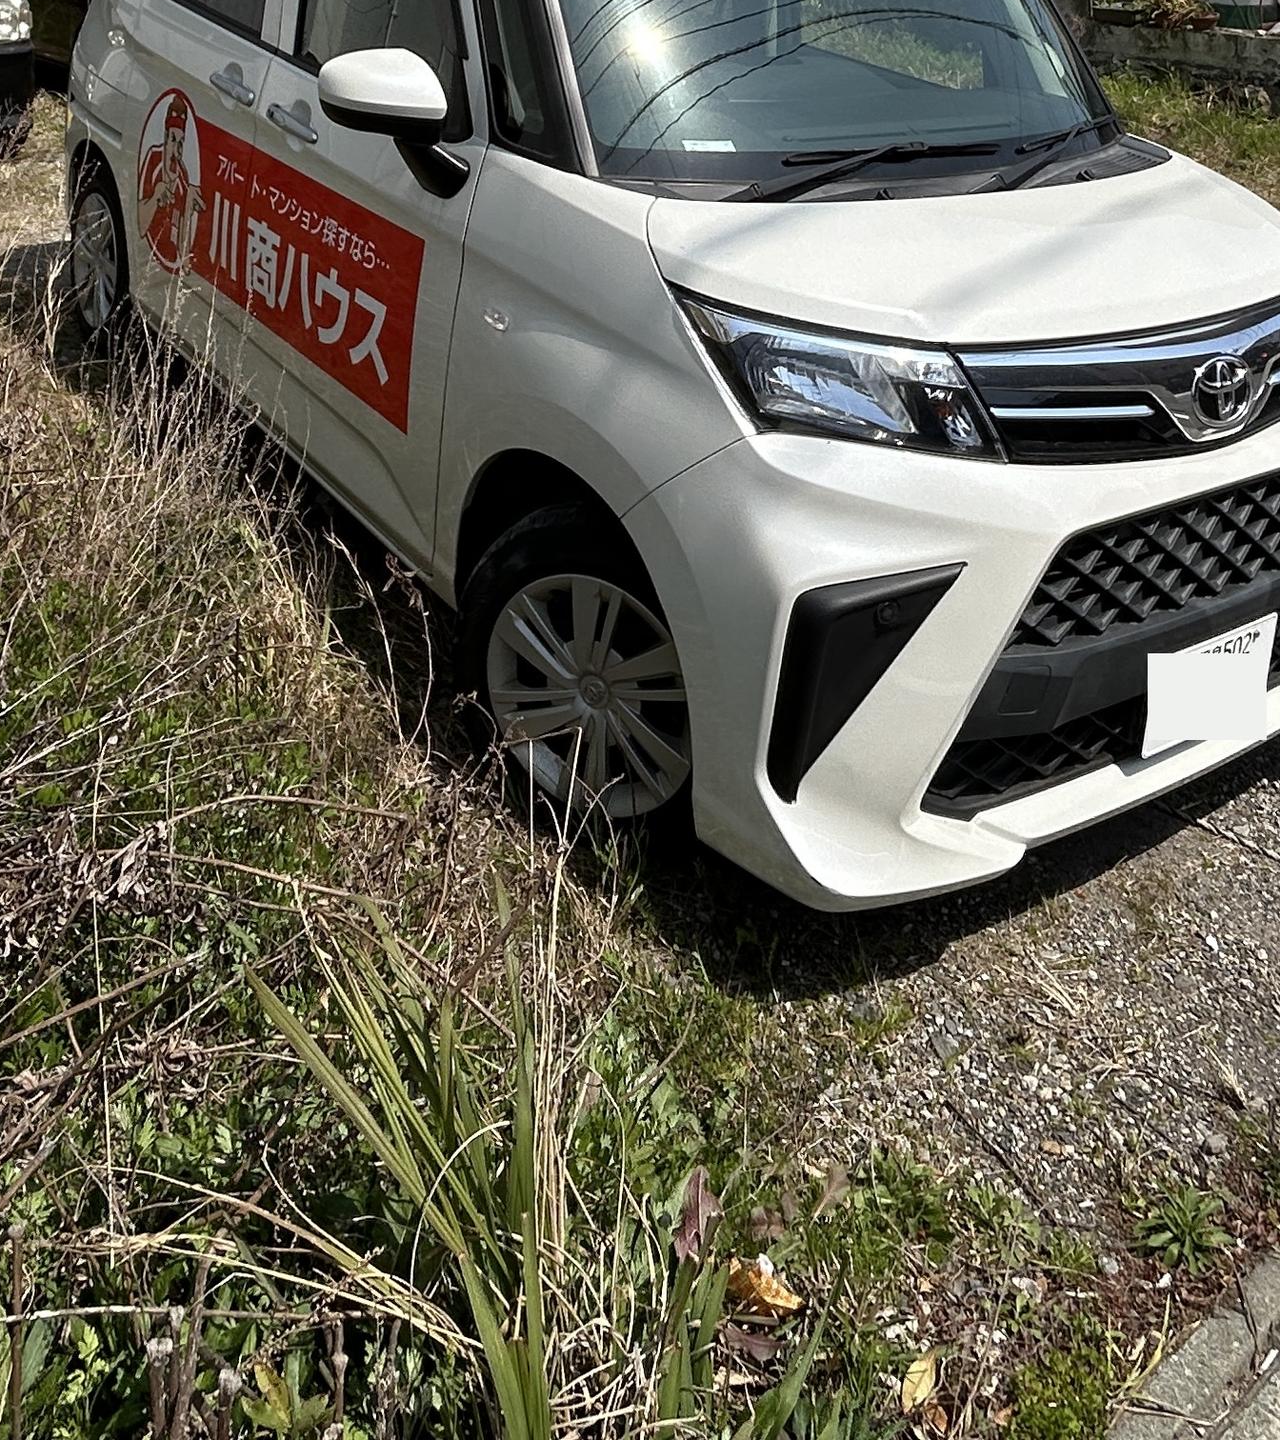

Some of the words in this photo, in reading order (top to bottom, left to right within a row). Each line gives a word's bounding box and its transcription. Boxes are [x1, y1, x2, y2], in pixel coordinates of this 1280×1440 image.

[208, 190, 389, 386] 川商ハウス
